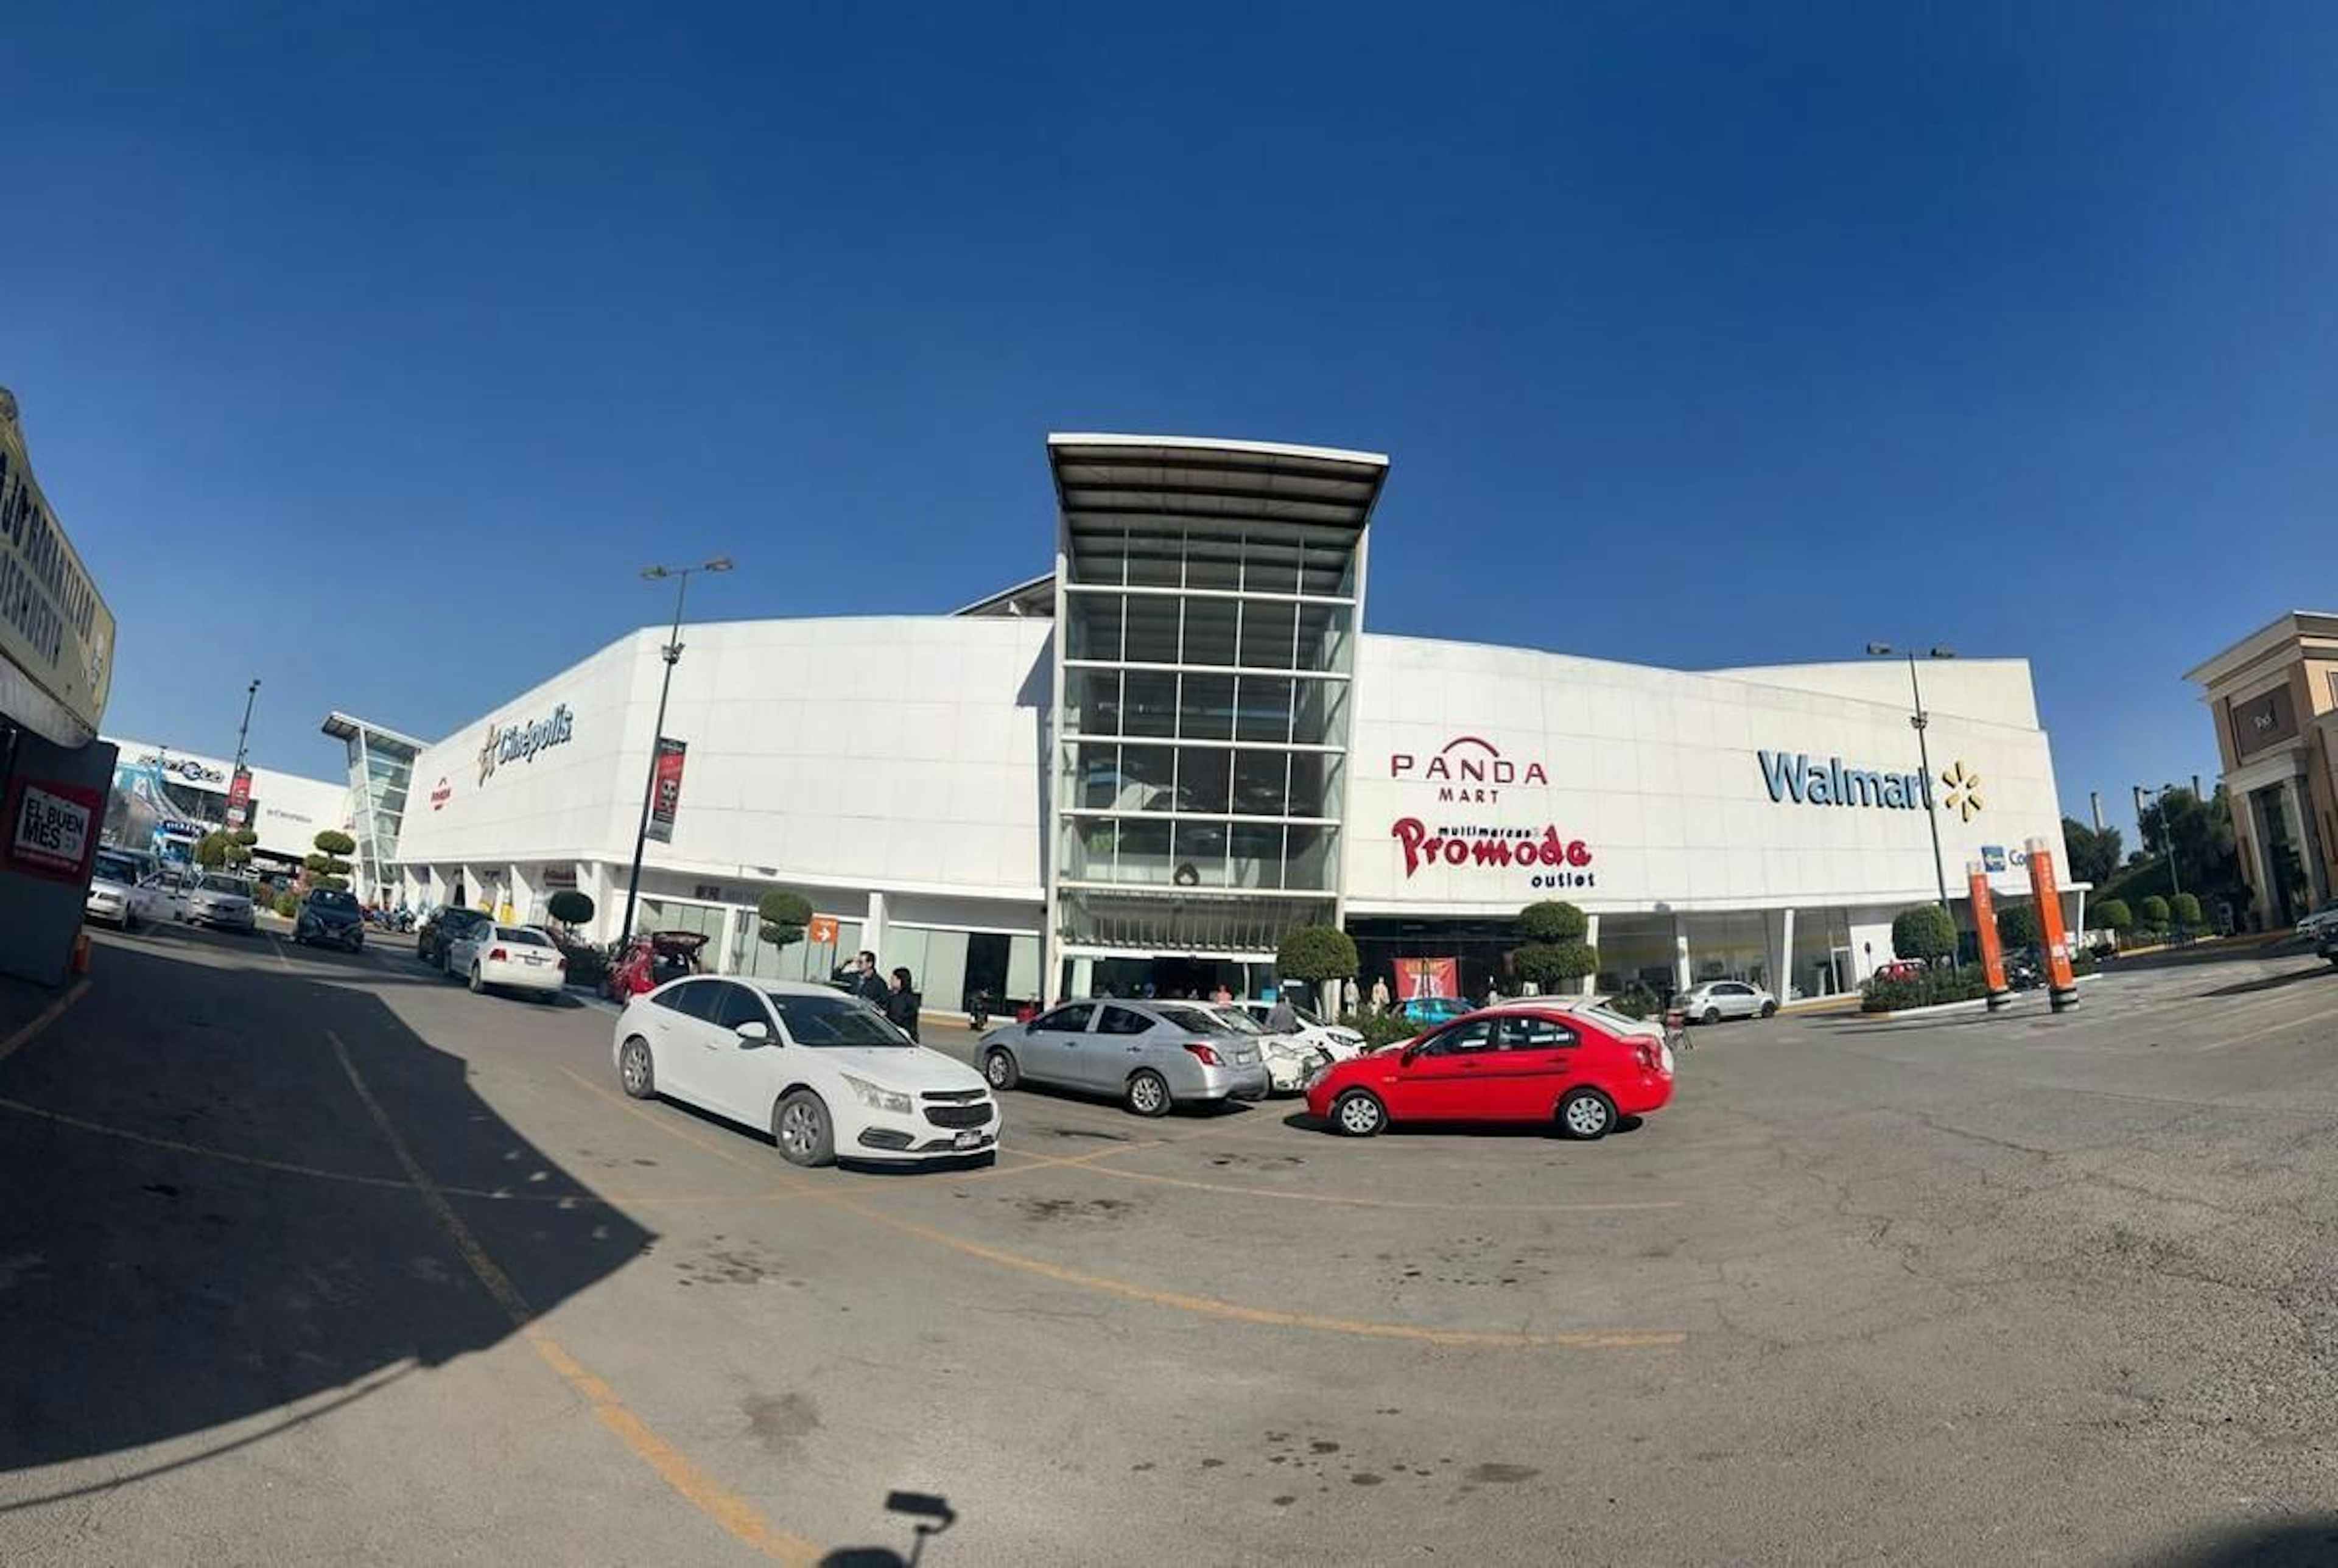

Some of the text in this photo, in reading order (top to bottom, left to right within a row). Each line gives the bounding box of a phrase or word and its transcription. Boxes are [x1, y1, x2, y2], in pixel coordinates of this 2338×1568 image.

[1391, 754, 1548, 785] PANDA
[1757, 750, 1934, 810] Walmart
[1439, 788, 1499, 803] MART
[26, 797, 85, 836] EL BUEN
[23, 818, 60, 849] MES
[1391, 817, 1592, 880] Promoda
[1531, 872, 1595, 888] outlet
